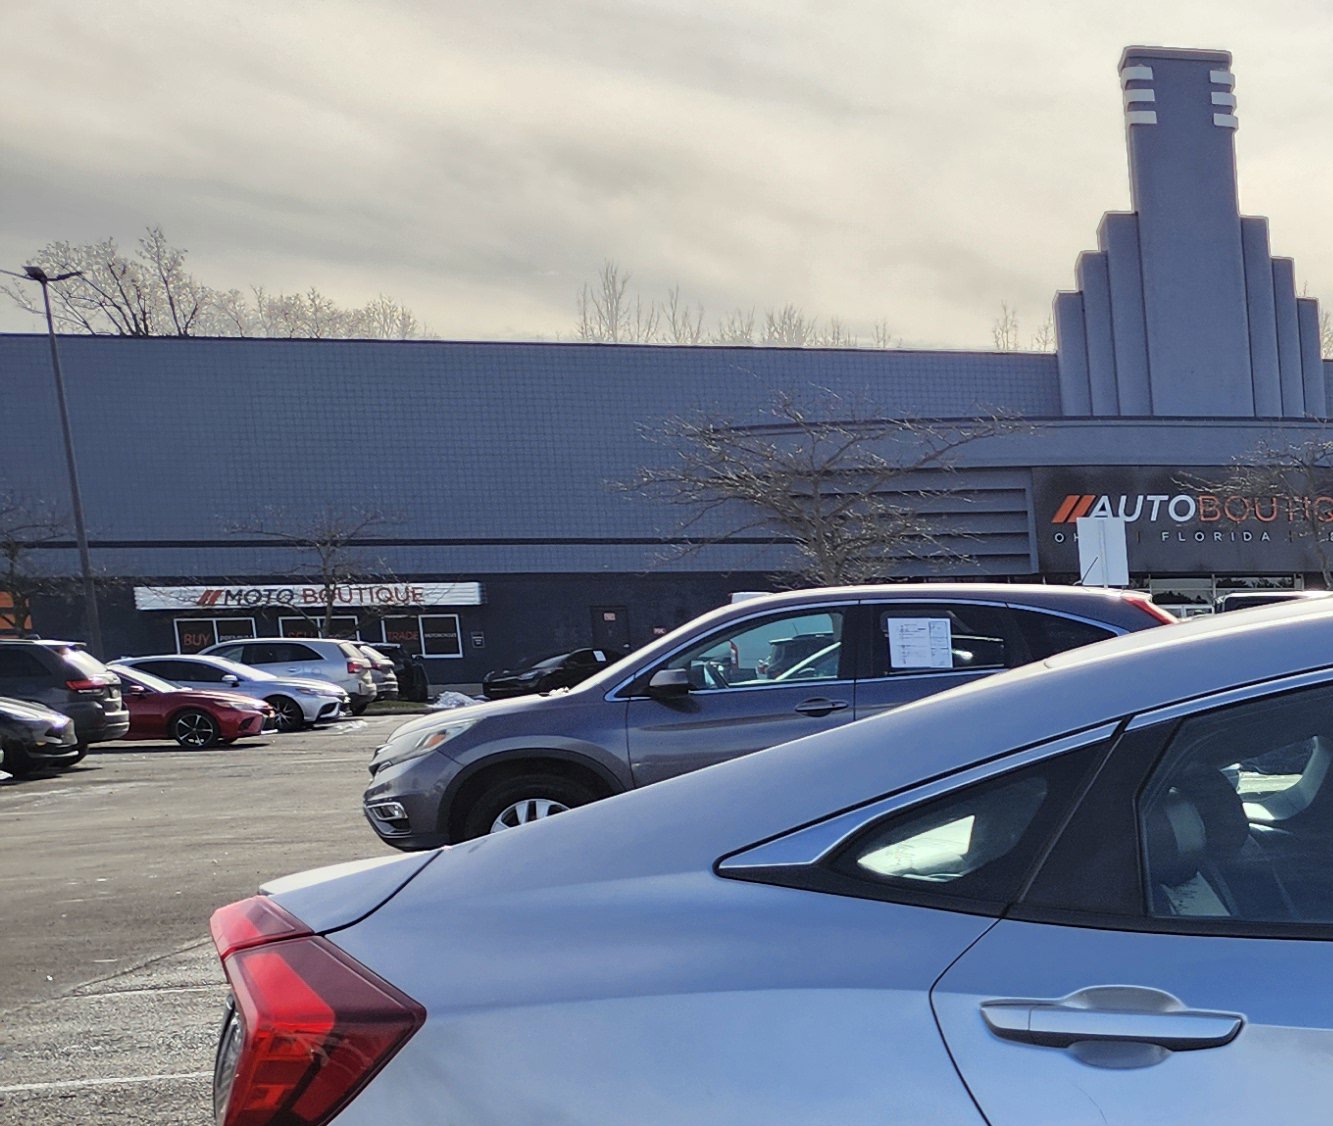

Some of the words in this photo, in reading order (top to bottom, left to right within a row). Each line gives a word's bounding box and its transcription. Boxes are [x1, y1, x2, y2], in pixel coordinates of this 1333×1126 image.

[1161, 531, 1271, 543] FLORIDA
[224, 588, 294, 606] MOTO
[302, 587, 425, 604] BOUTIQUE
[183, 633, 211, 646] BUY
[387, 631, 419, 641] TRADE
